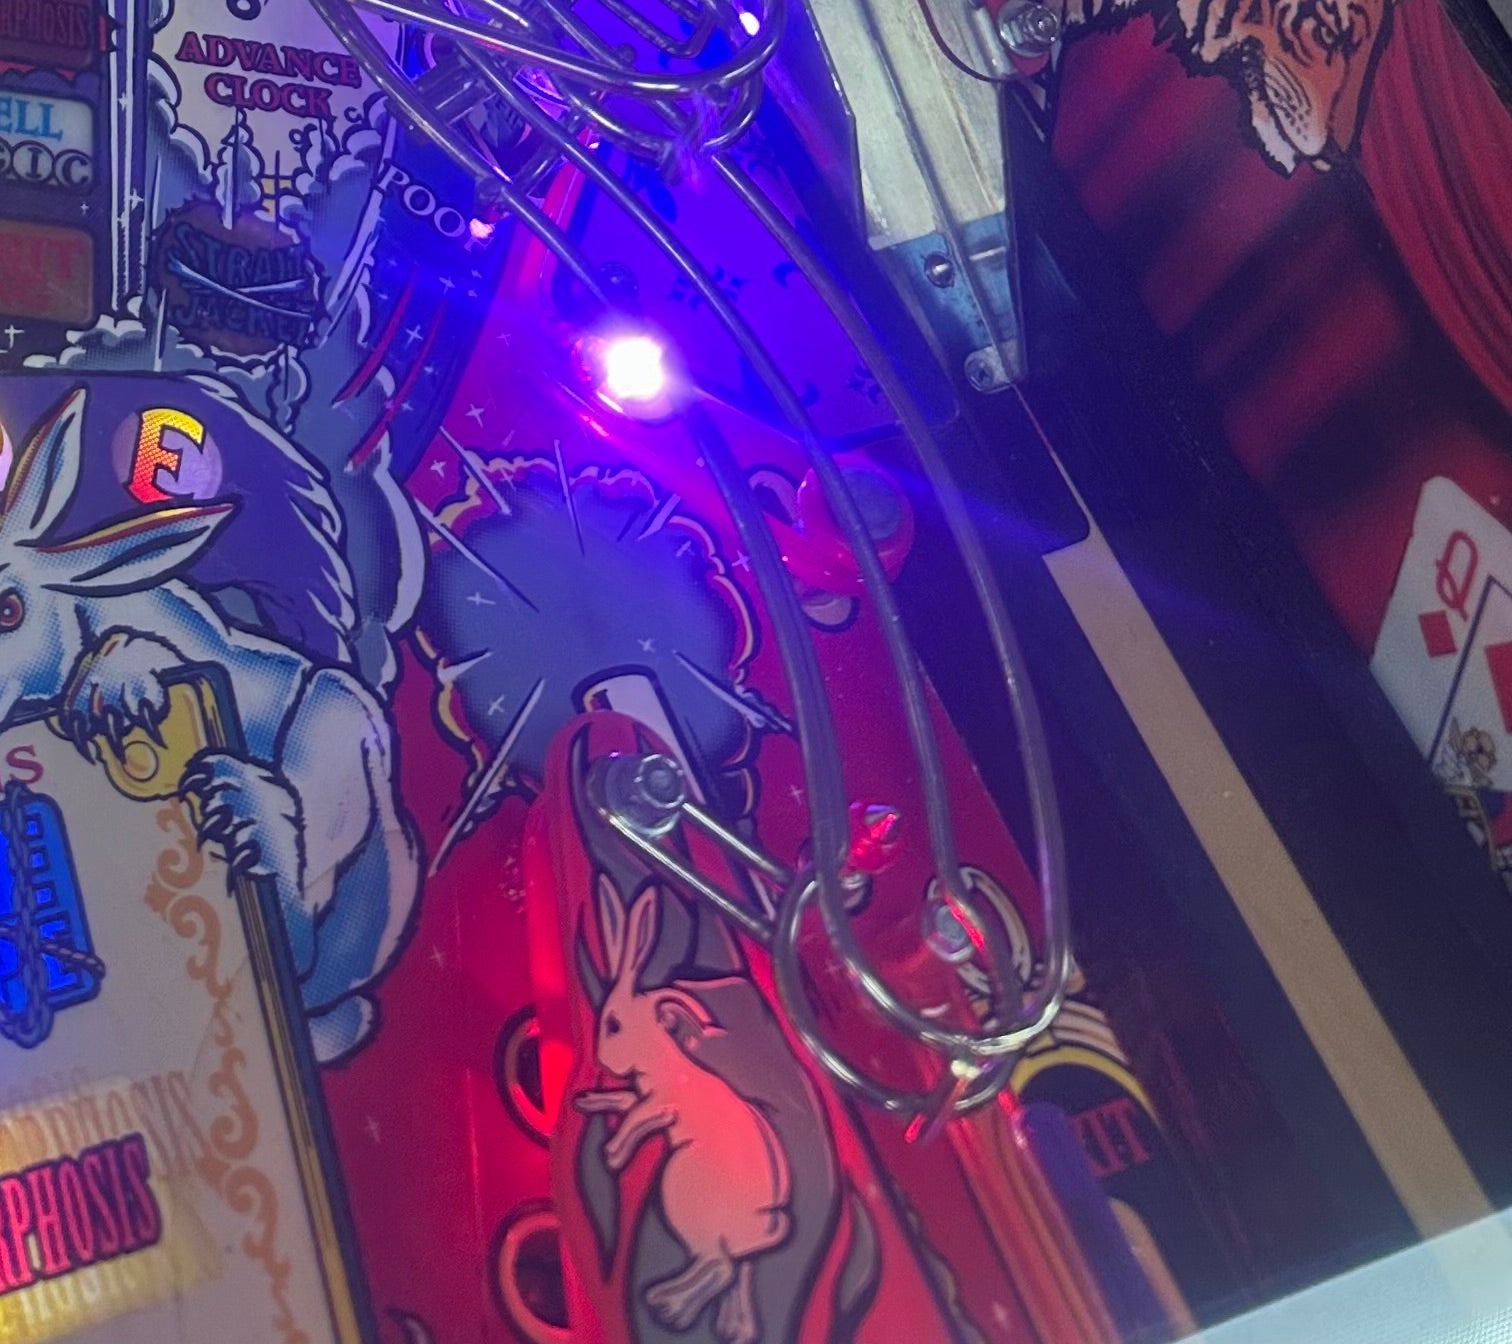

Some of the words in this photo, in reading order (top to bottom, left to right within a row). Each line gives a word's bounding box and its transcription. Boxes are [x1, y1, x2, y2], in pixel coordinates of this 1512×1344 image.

[175, 31, 363, 89] ADVANCE
[203, 72, 334, 119] CLOCK
[1435, 529, 1479, 622] Q
